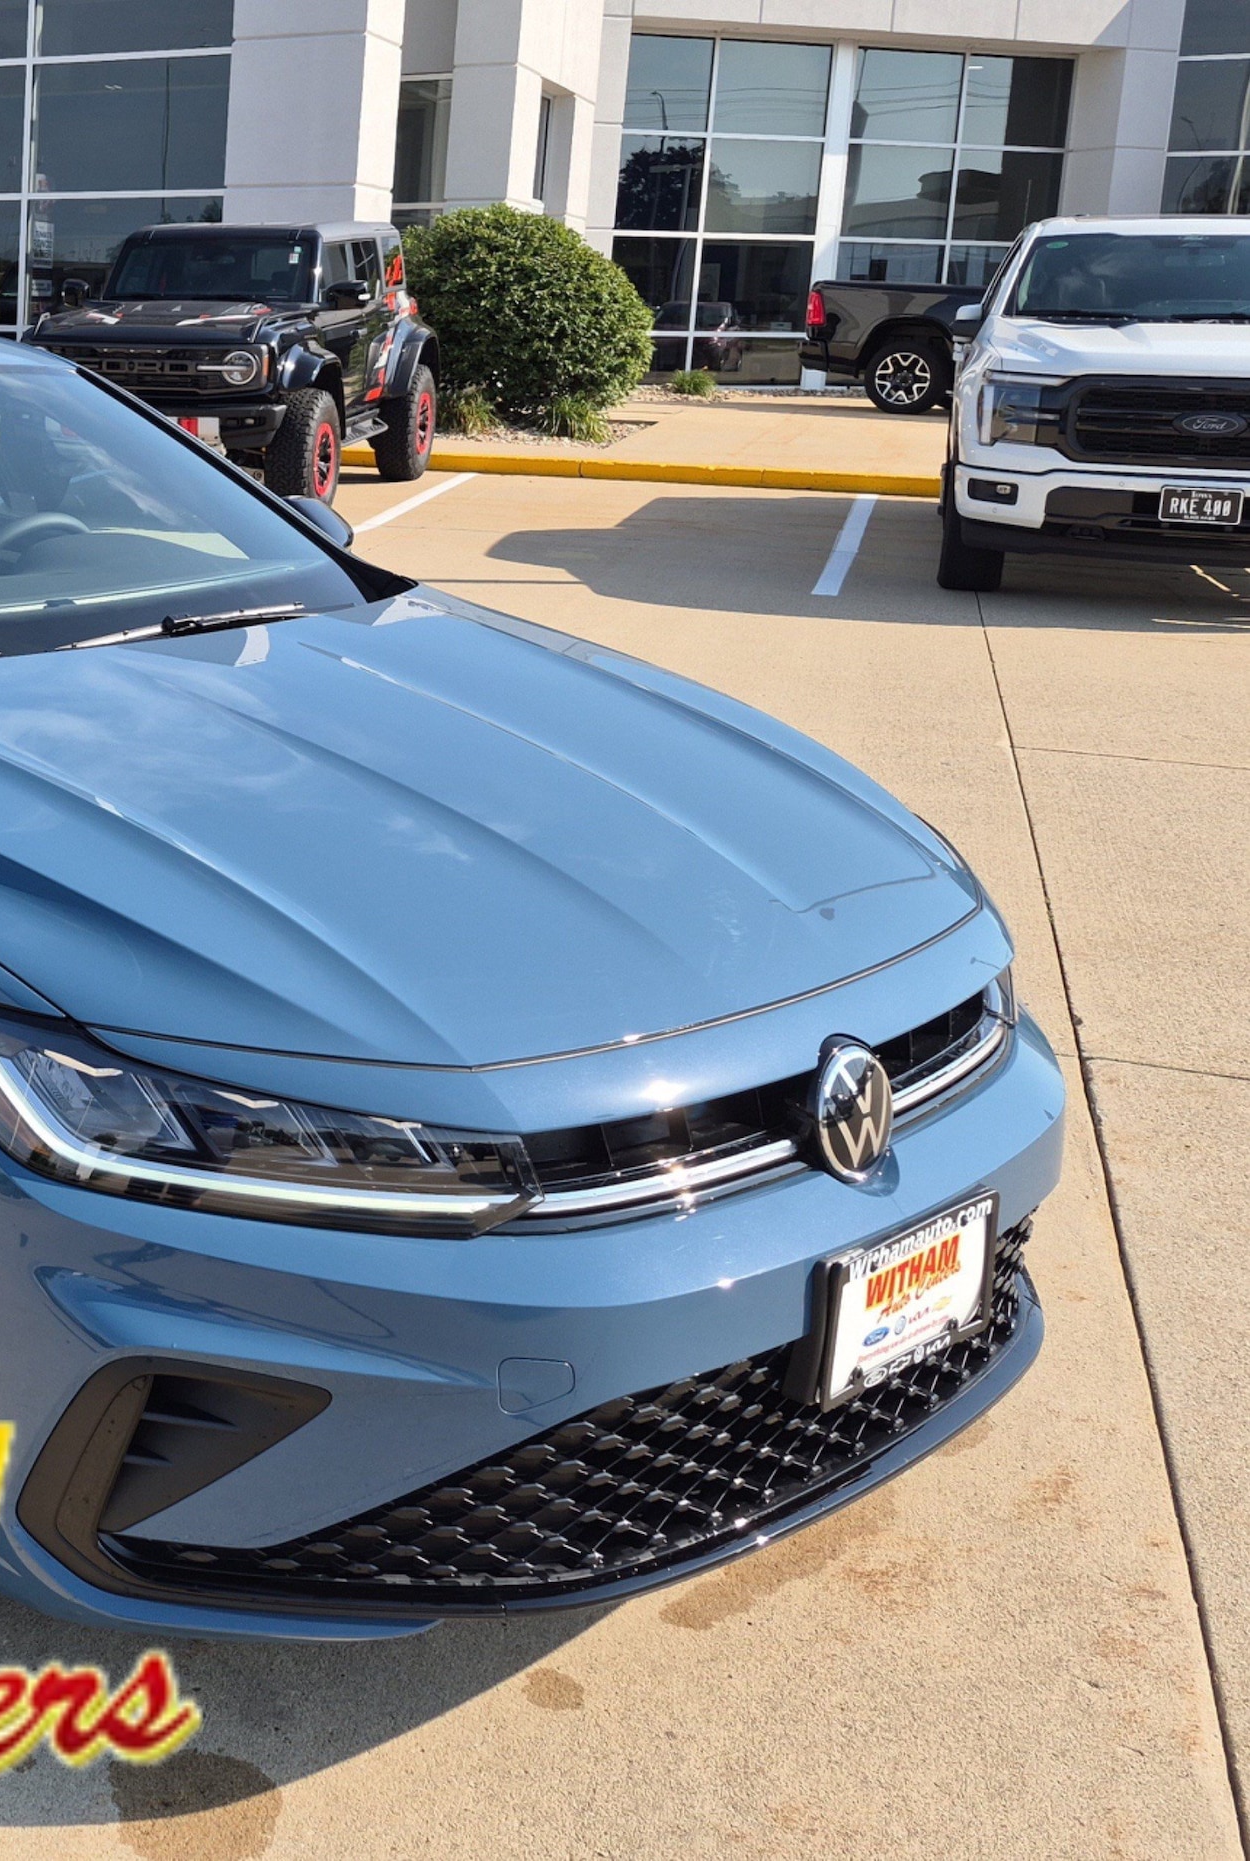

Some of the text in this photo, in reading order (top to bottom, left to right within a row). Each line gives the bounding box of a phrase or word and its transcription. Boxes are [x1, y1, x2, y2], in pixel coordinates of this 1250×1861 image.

[1192, 417, 1228, 430] Ford
[1169, 497, 1232, 517] RKE 400
[865, 1232, 961, 1310] WITHAM
